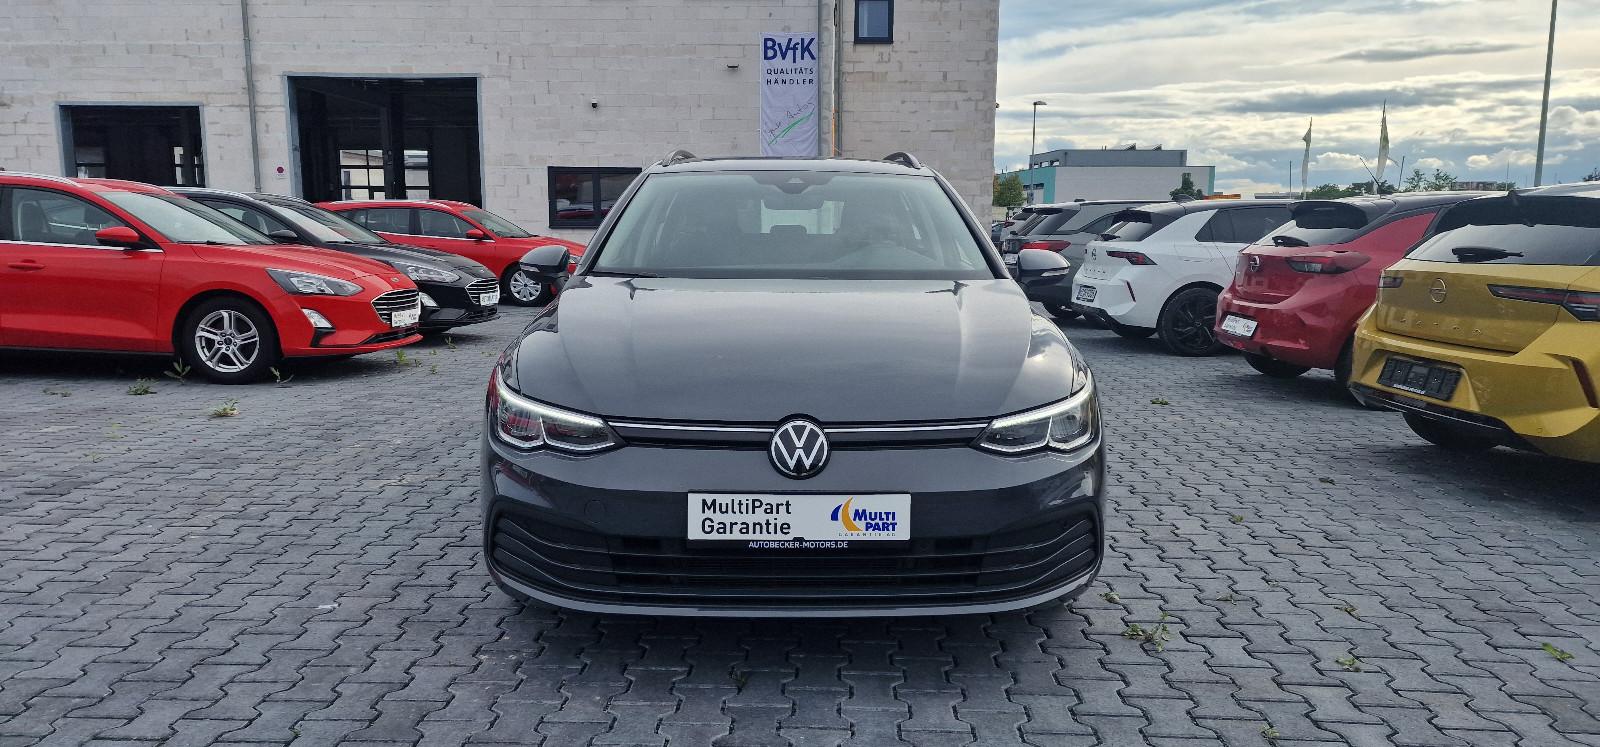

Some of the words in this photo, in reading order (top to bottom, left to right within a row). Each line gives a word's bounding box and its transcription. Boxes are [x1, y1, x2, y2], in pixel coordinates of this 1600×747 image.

[763, 37, 817, 64] BVfK
[766, 67, 814, 76] QUALITÄTS
[766, 77, 814, 86] HÄNDLER
[771, 420, 828, 475] VW
[701, 498, 792, 515] MultiPart
[701, 517, 792, 535] Garantie
[865, 521, 898, 532] PART
[748, 541, 849, 549] AUTOBECKER-MOTORS.DE
